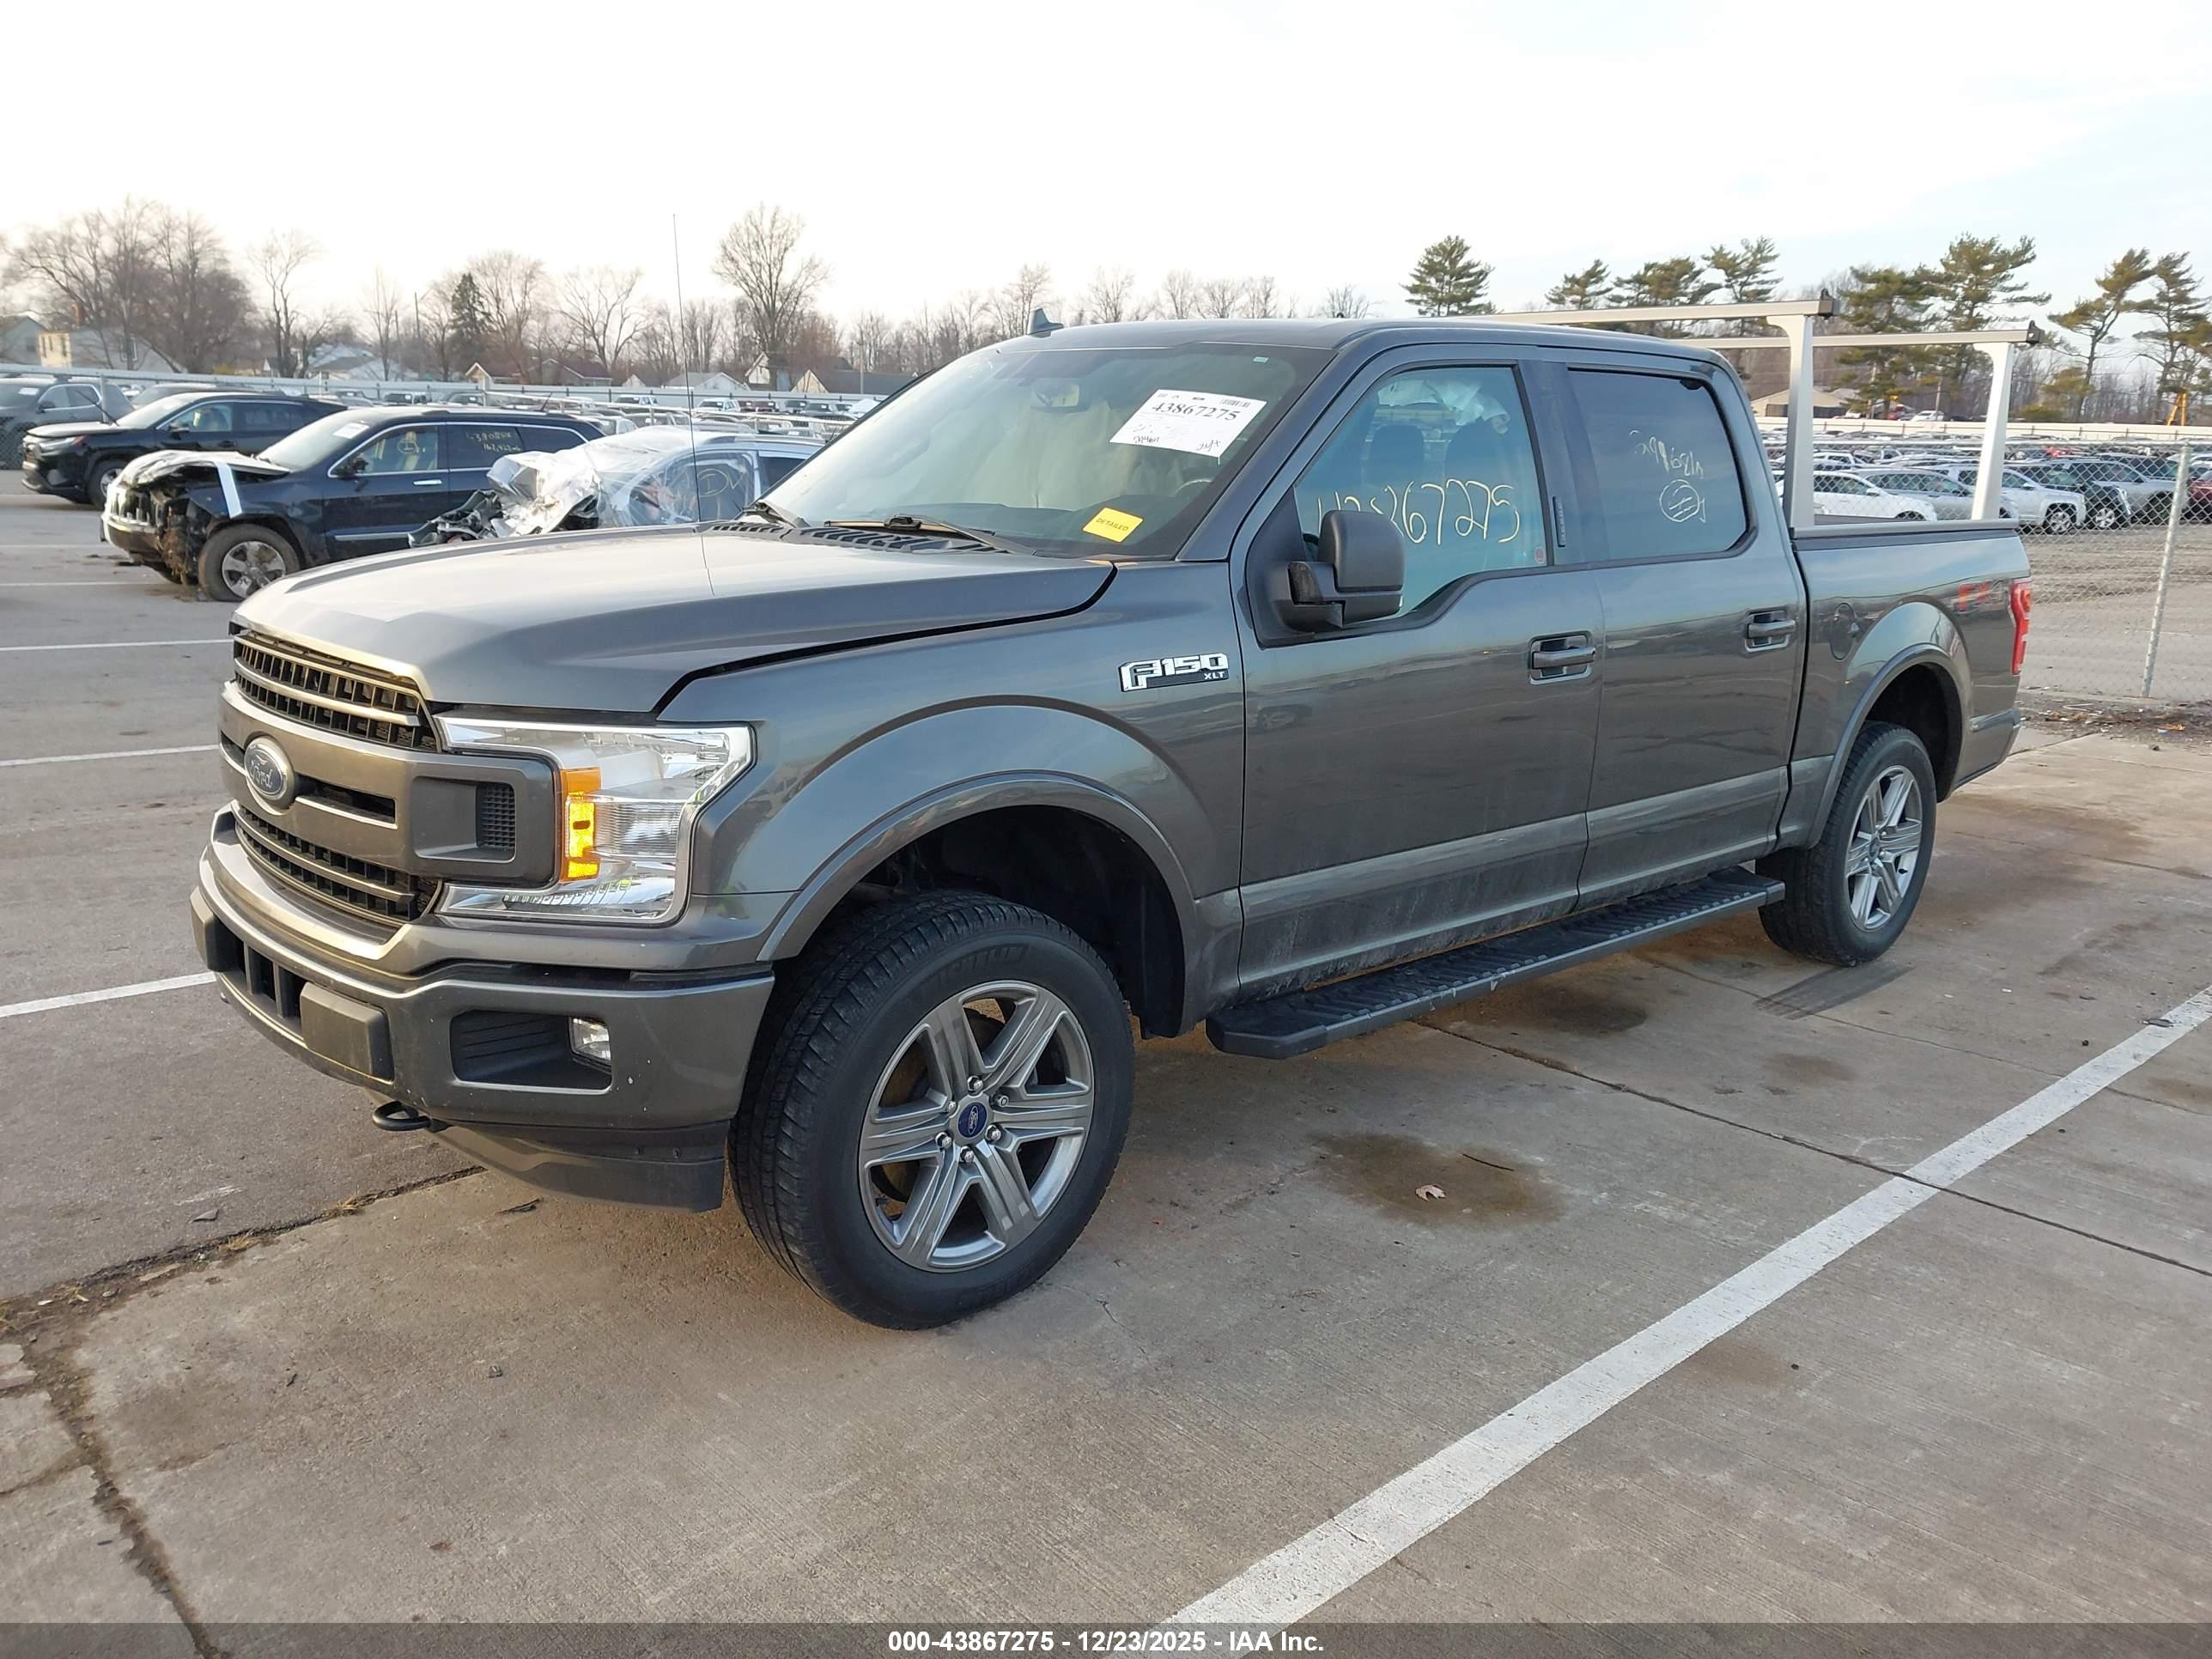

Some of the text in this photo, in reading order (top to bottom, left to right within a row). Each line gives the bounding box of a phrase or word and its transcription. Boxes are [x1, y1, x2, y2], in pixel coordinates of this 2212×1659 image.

[1152, 402, 1241, 421] 43867275
[1095, 517, 1129, 532] DETAILED
[1204, 671, 1225, 681] XLT
[249, 754, 275, 789] Ford
